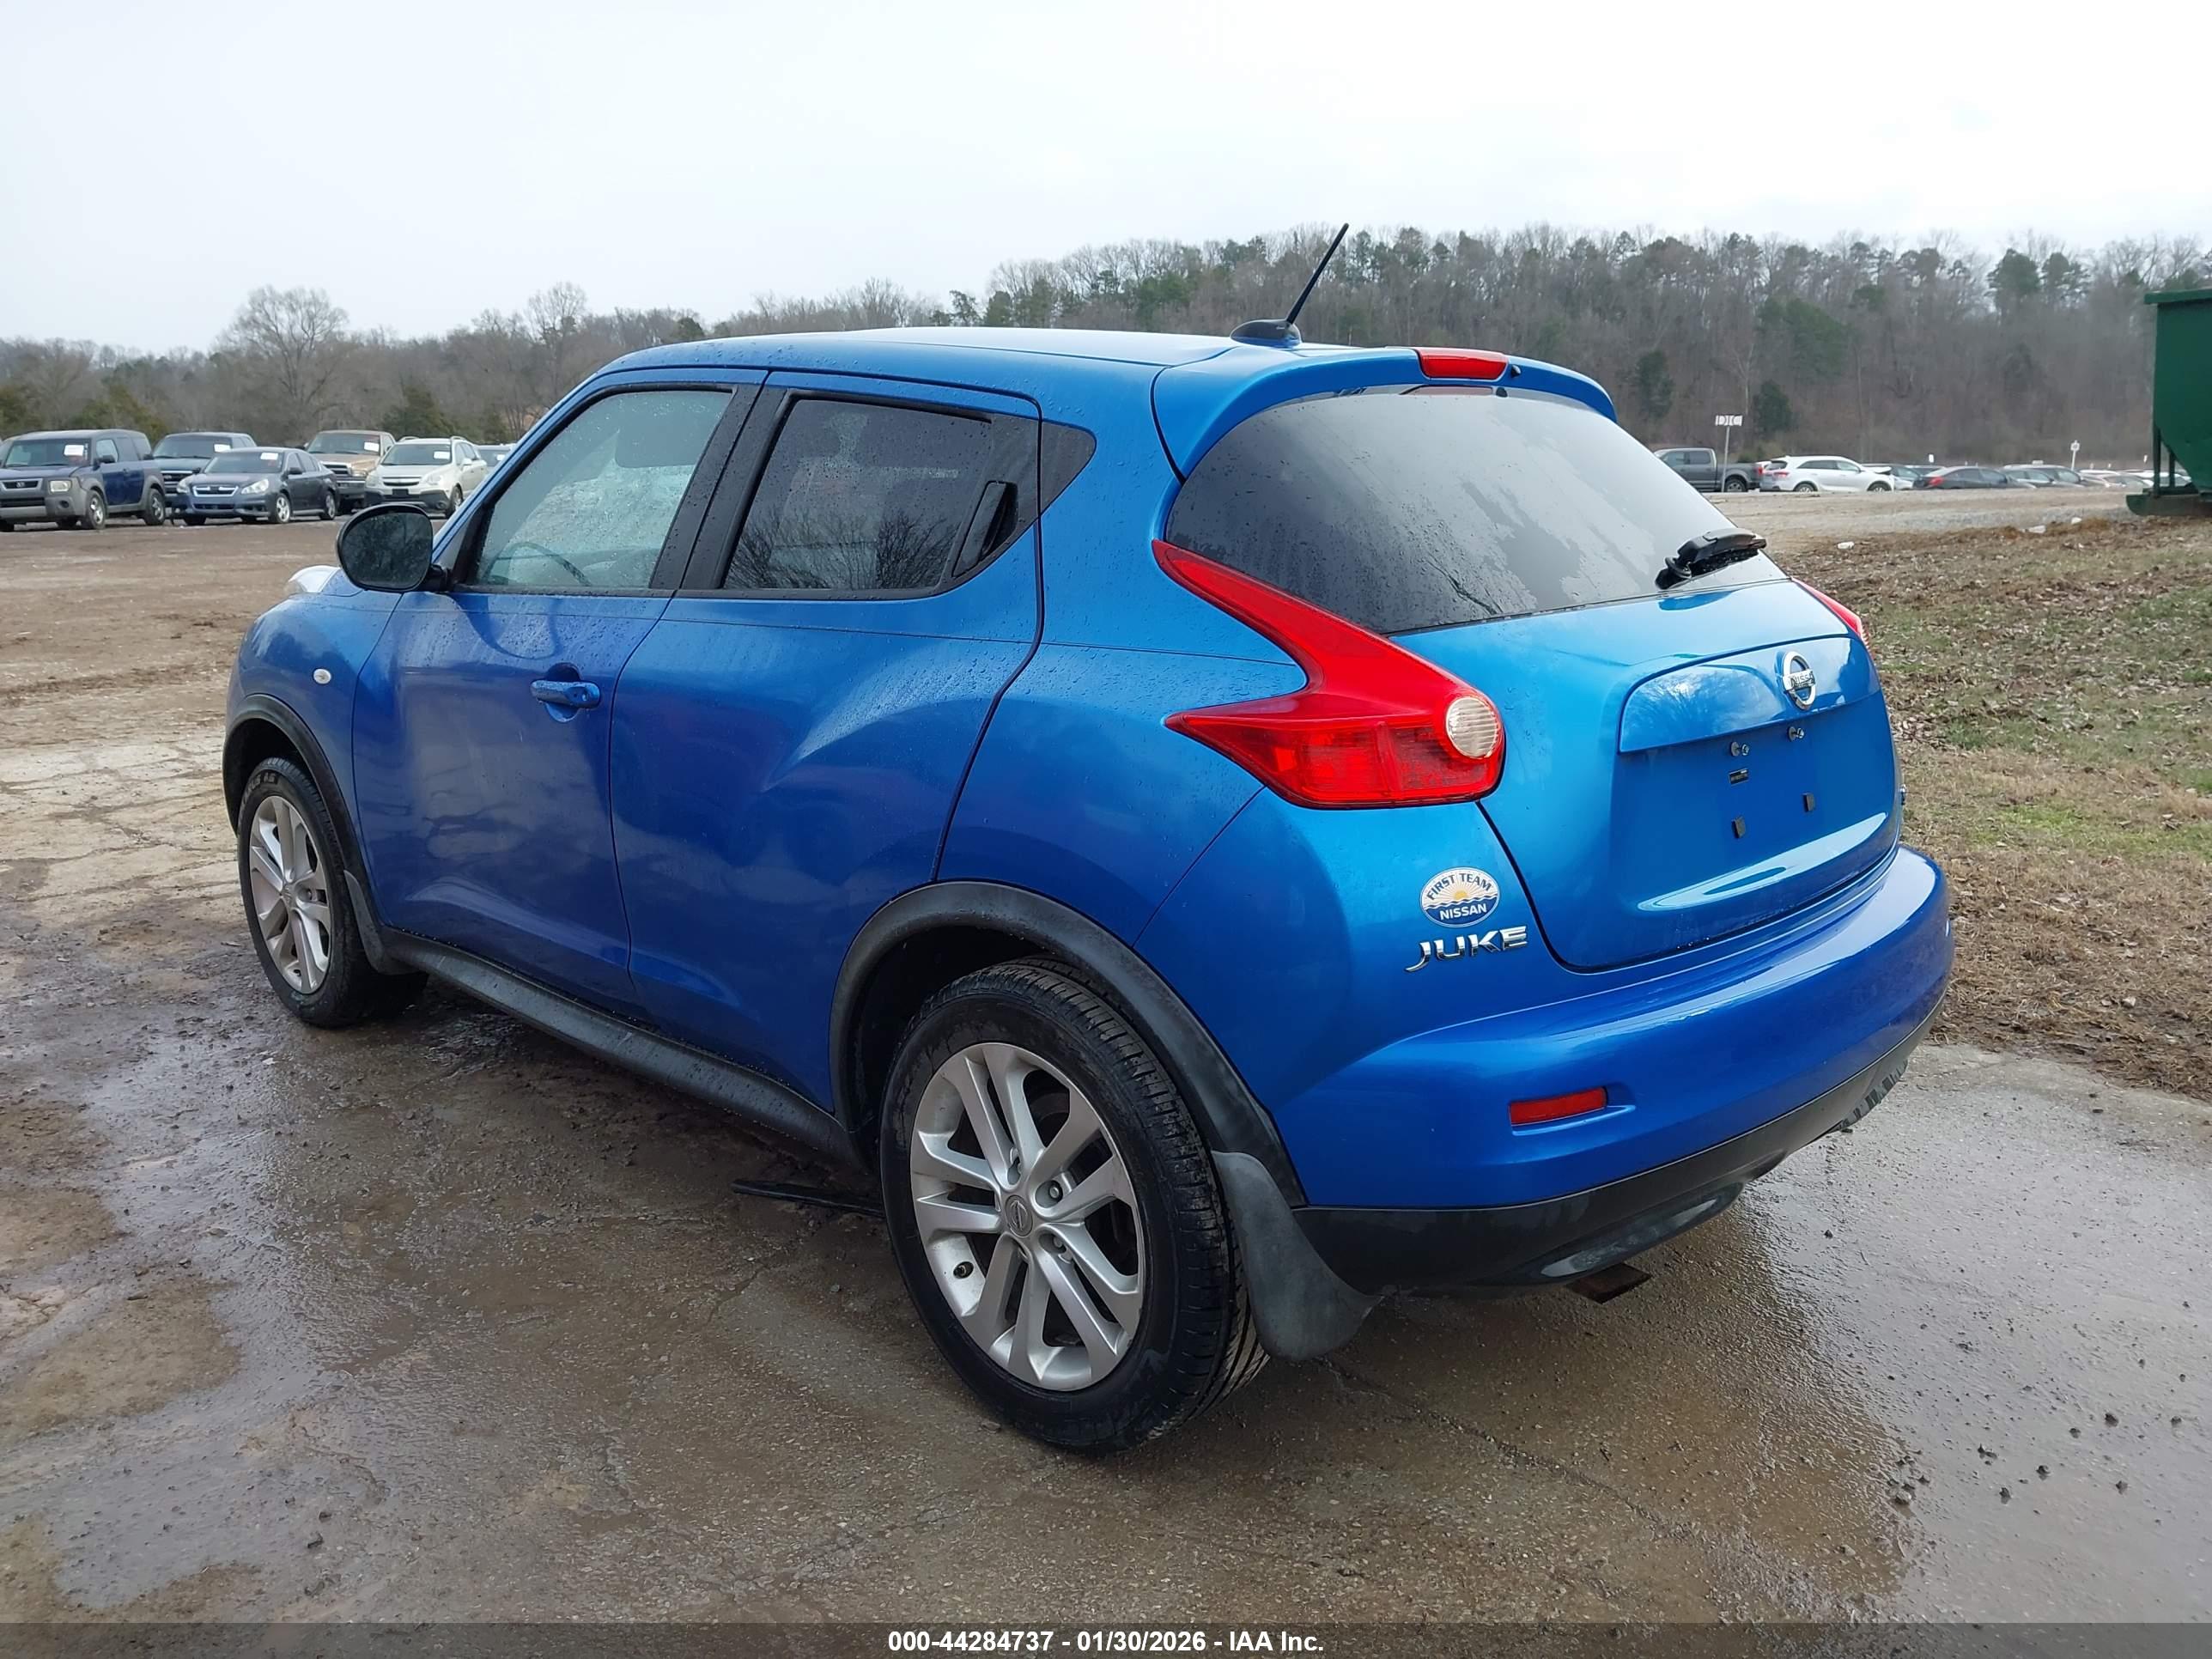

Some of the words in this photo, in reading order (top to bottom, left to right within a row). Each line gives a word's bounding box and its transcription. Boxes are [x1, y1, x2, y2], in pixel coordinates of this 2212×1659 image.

[1426, 874, 1455, 901] FIRST
[1459, 872, 1492, 891] TEAM
[1440, 903, 1487, 921] NISSAN
[1404, 926, 1528, 972] JUKE
